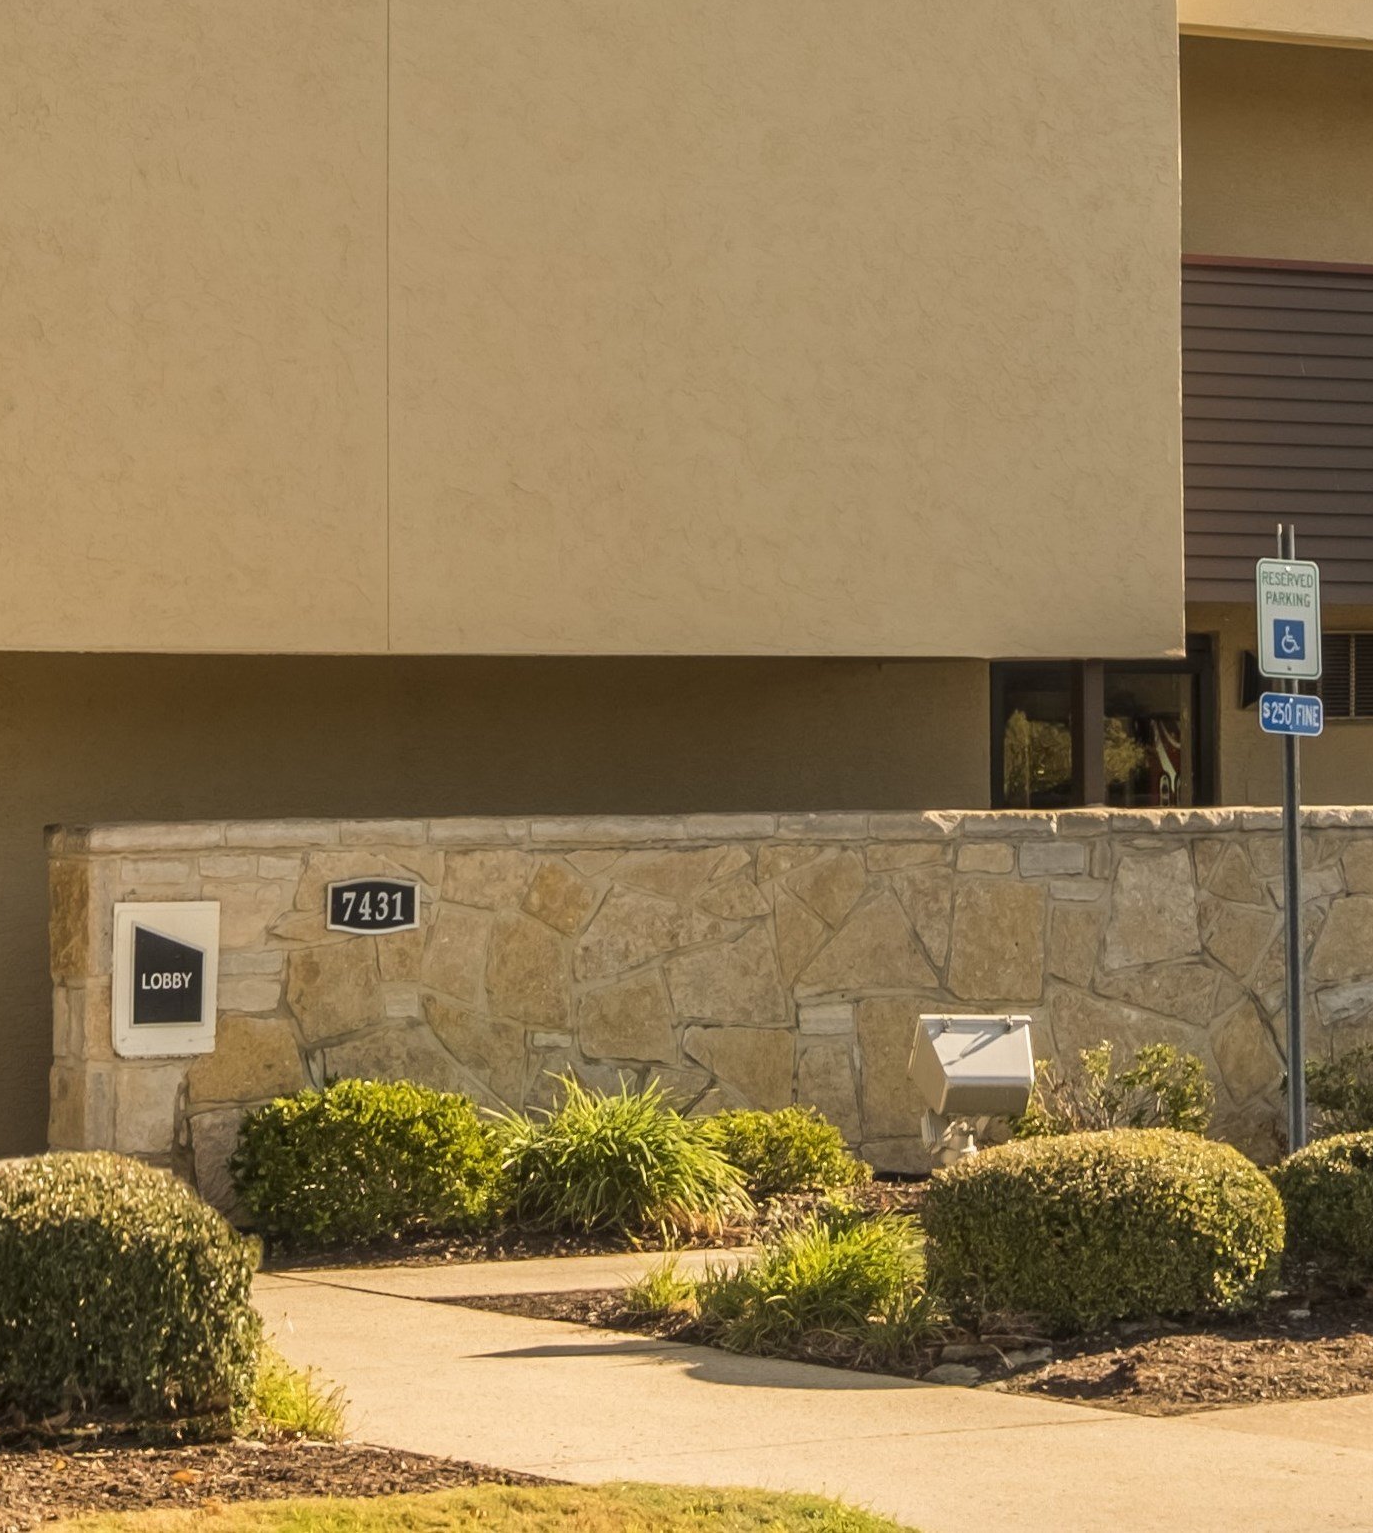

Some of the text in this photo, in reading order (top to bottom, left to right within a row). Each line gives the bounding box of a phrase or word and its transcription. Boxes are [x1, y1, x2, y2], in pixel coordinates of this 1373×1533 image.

[1261, 570, 1314, 588] RESERVED
[1265, 590, 1312, 608] PARKING
[1262, 701, 1320, 727] $250 FINE
[342, 890, 405, 922] 7431
[141, 971, 193, 990] LOBBY
